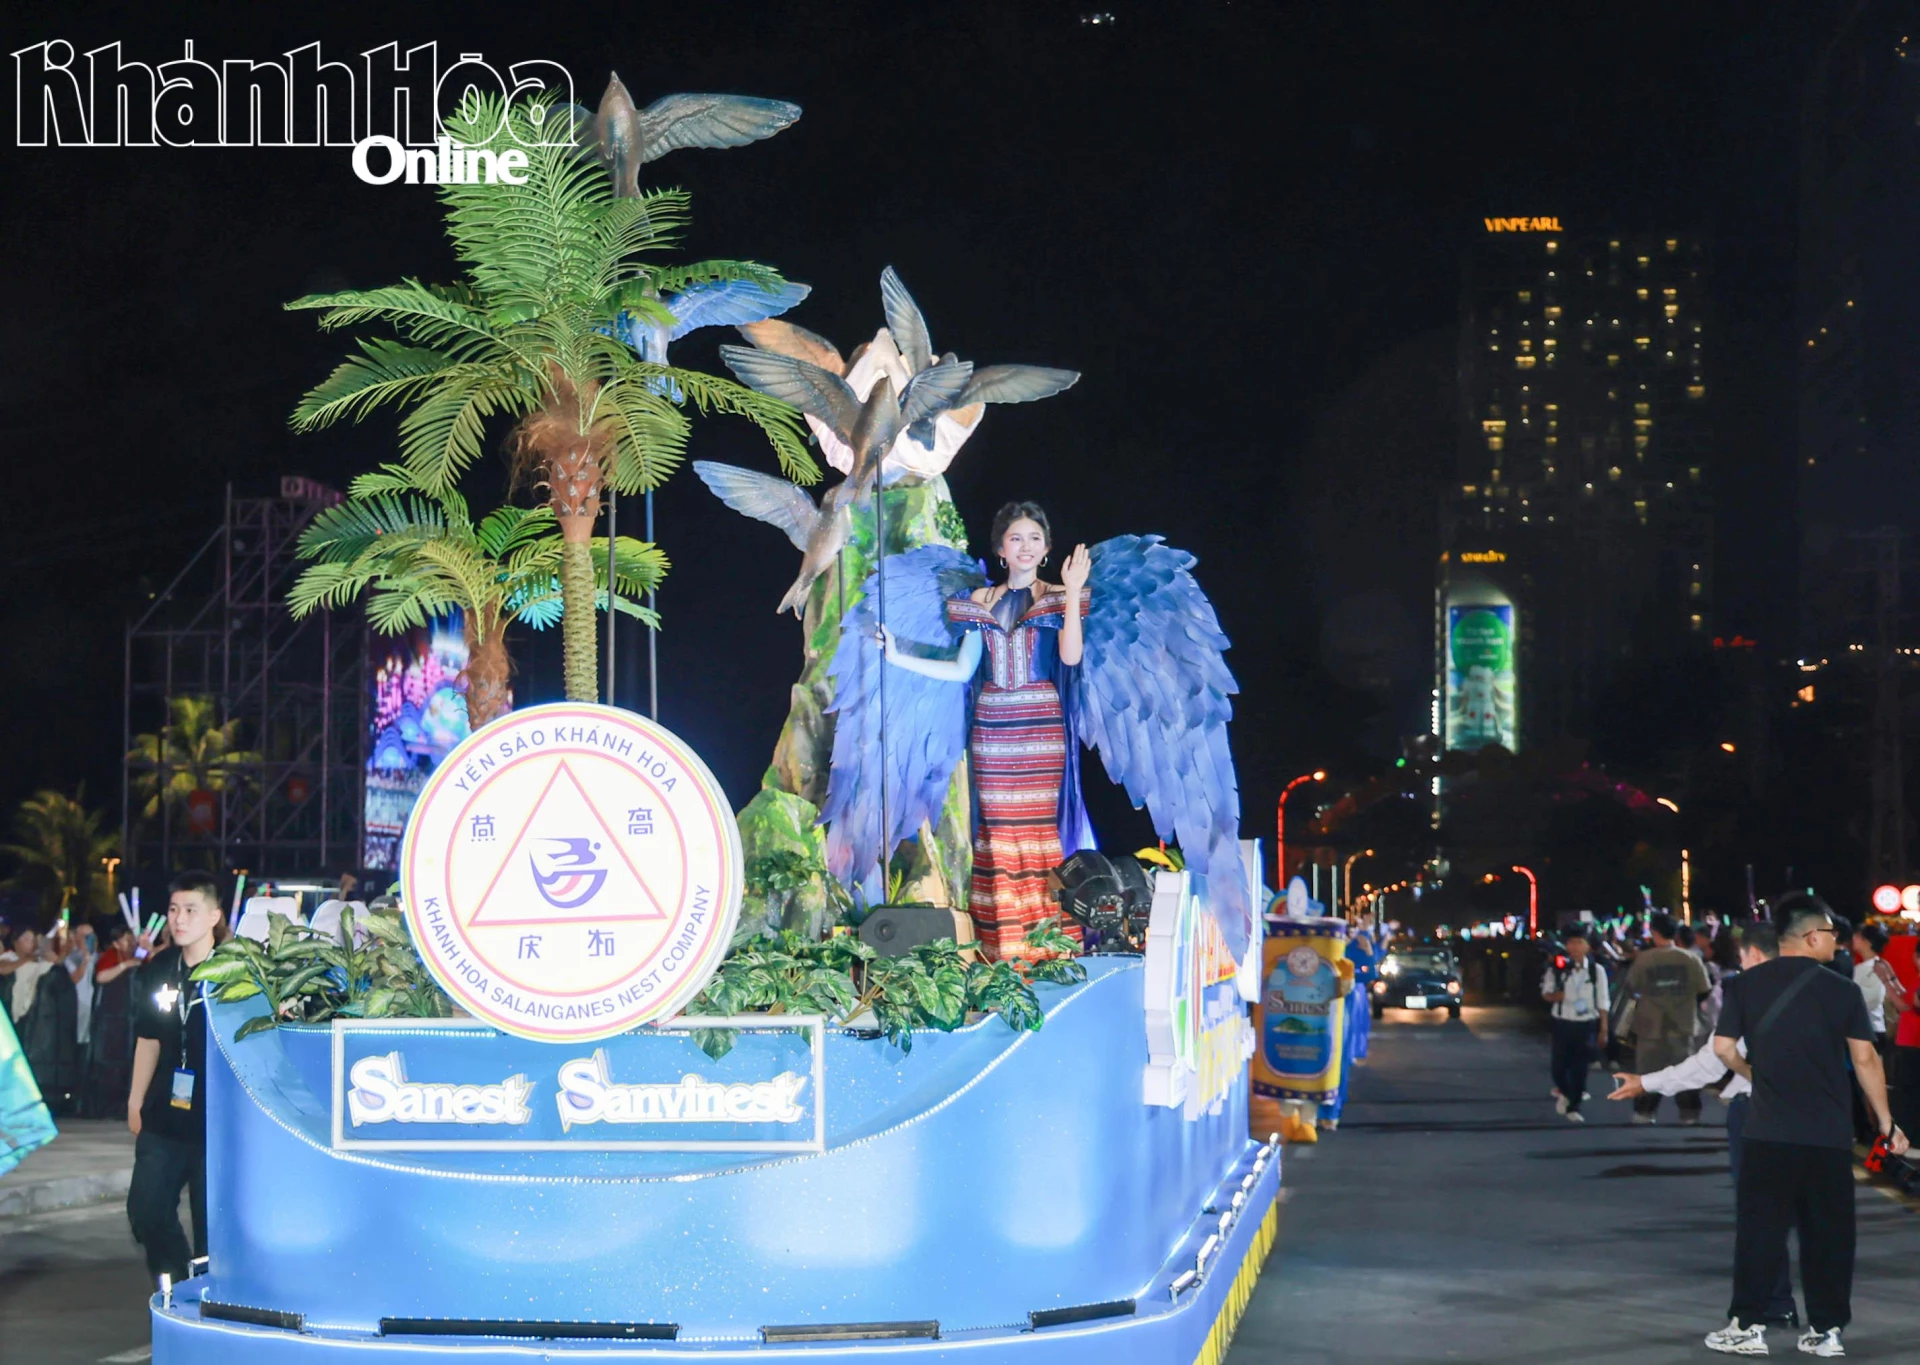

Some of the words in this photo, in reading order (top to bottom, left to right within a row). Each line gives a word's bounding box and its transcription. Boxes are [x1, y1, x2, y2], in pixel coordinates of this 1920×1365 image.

[1484, 216, 1563, 232] VINPEARL
[454, 758, 496, 792] YẾN
[499, 730, 546, 758] SÀO
[554, 725, 633, 757] KHÁNH
[636, 750, 678, 793] HÒA
[423, 896, 461, 961] KHANH
[455, 958, 489, 994] HOA
[490, 986, 616, 1021] SALANGANES
[617, 968, 662, 1008] NEST
[661, 884, 711, 973] COMPANY
[349, 1053, 531, 1127] Sanest
[557, 1049, 806, 1132] Sanvinest
